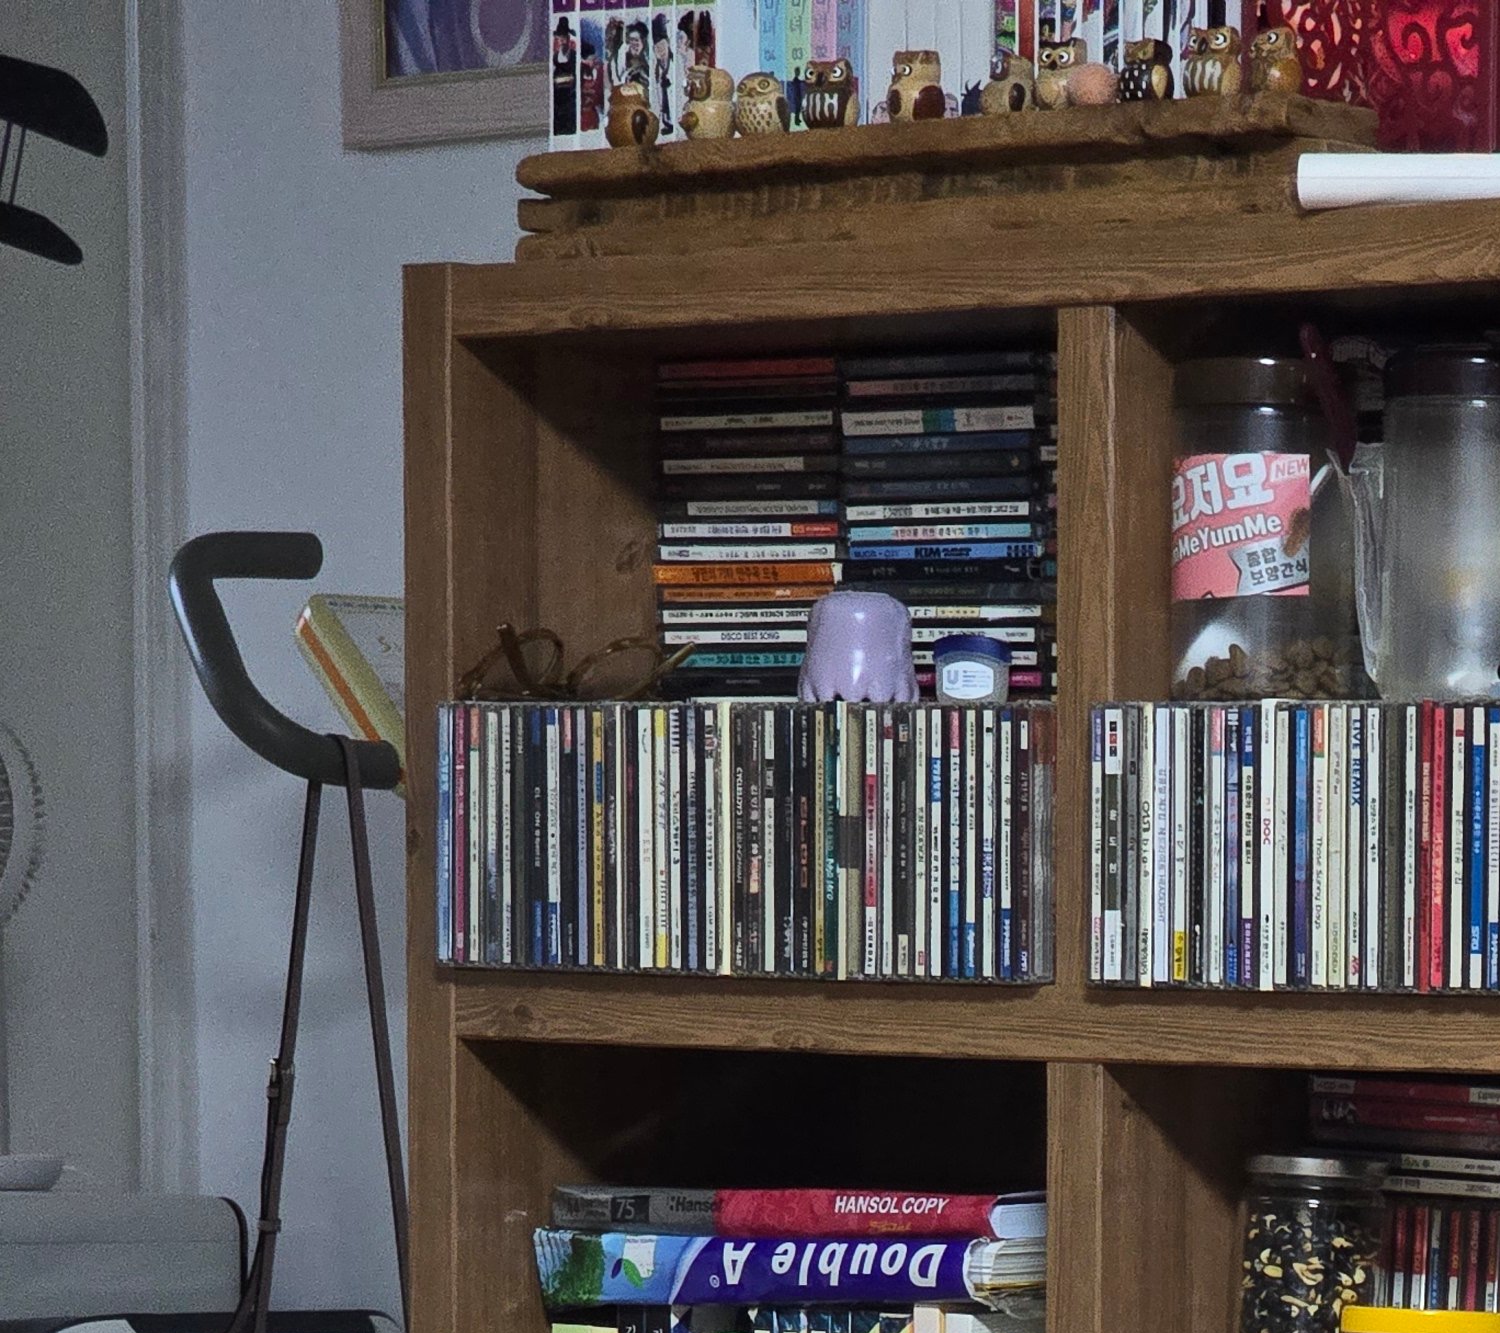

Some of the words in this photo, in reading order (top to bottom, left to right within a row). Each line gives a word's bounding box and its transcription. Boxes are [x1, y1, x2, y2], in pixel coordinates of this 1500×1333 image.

[1275, 459, 1309, 478] NEW
[617, 1200, 636, 1217] 75
[834, 1196, 901, 1215] HANSOL
[902, 1197, 950, 1215] COPY
[722, 1241, 755, 1285] A
[770, 1243, 948, 1288] Double
